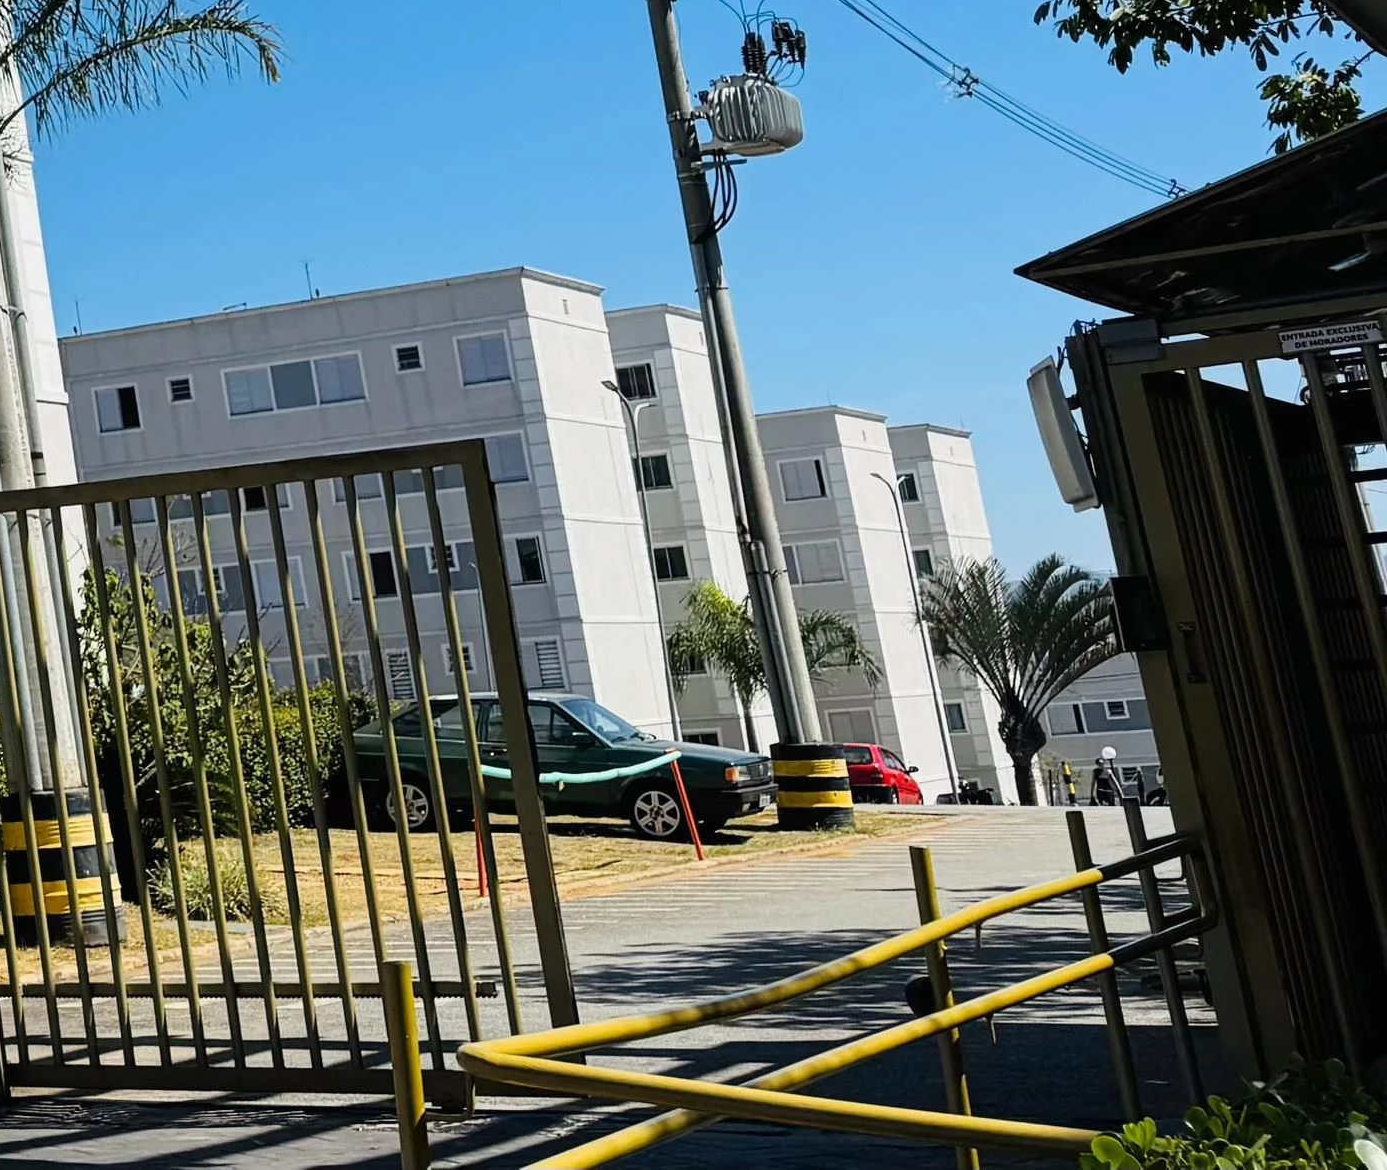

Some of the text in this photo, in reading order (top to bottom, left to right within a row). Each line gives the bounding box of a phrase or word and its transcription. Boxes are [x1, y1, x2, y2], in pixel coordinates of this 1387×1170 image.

[1282, 323, 1379, 341] ENTRADA EXCLUSIVA
[1295, 333, 1369, 349] DE MORADORES
